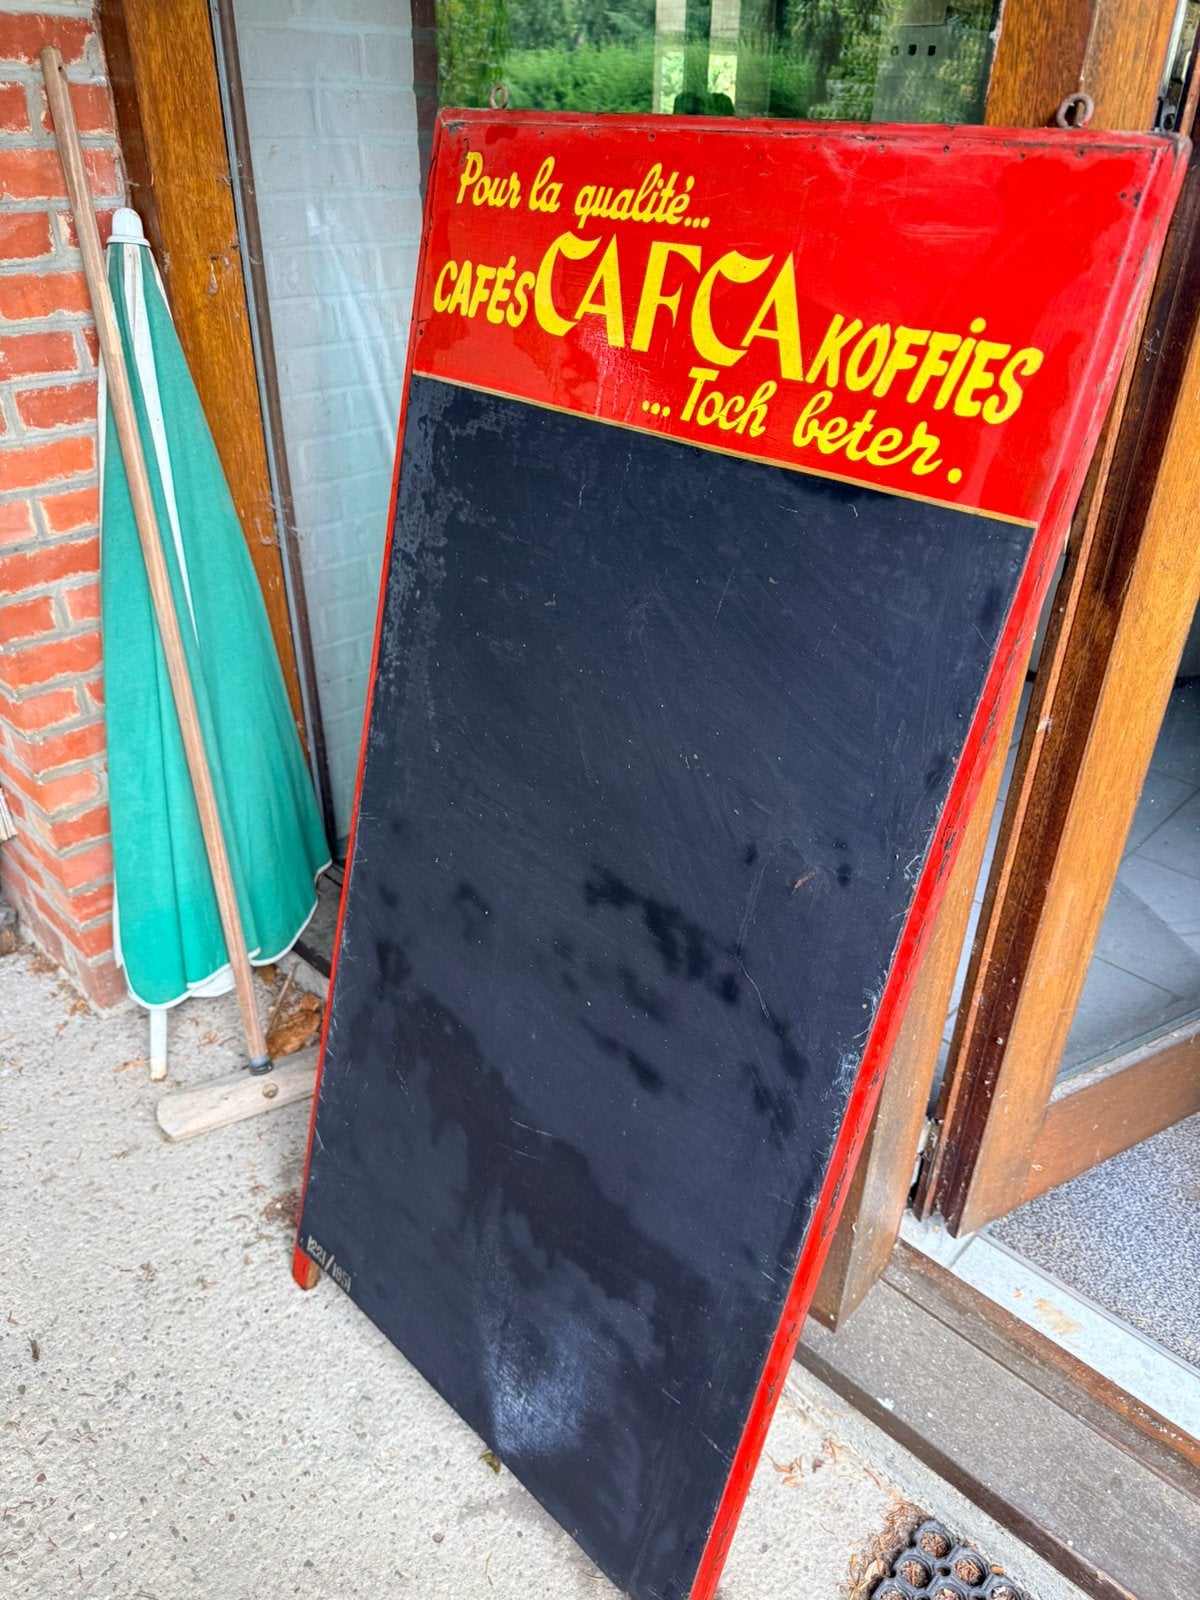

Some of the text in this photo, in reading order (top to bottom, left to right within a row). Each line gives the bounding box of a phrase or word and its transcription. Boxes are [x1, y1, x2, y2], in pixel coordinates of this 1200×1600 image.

[456, 151, 521, 210] Pour
[528, 156, 563, 213] la
[433, 255, 537, 329] CAFÉS
[534, 231, 804, 382] CAFCA
[792, 390, 963, 485] beter.
